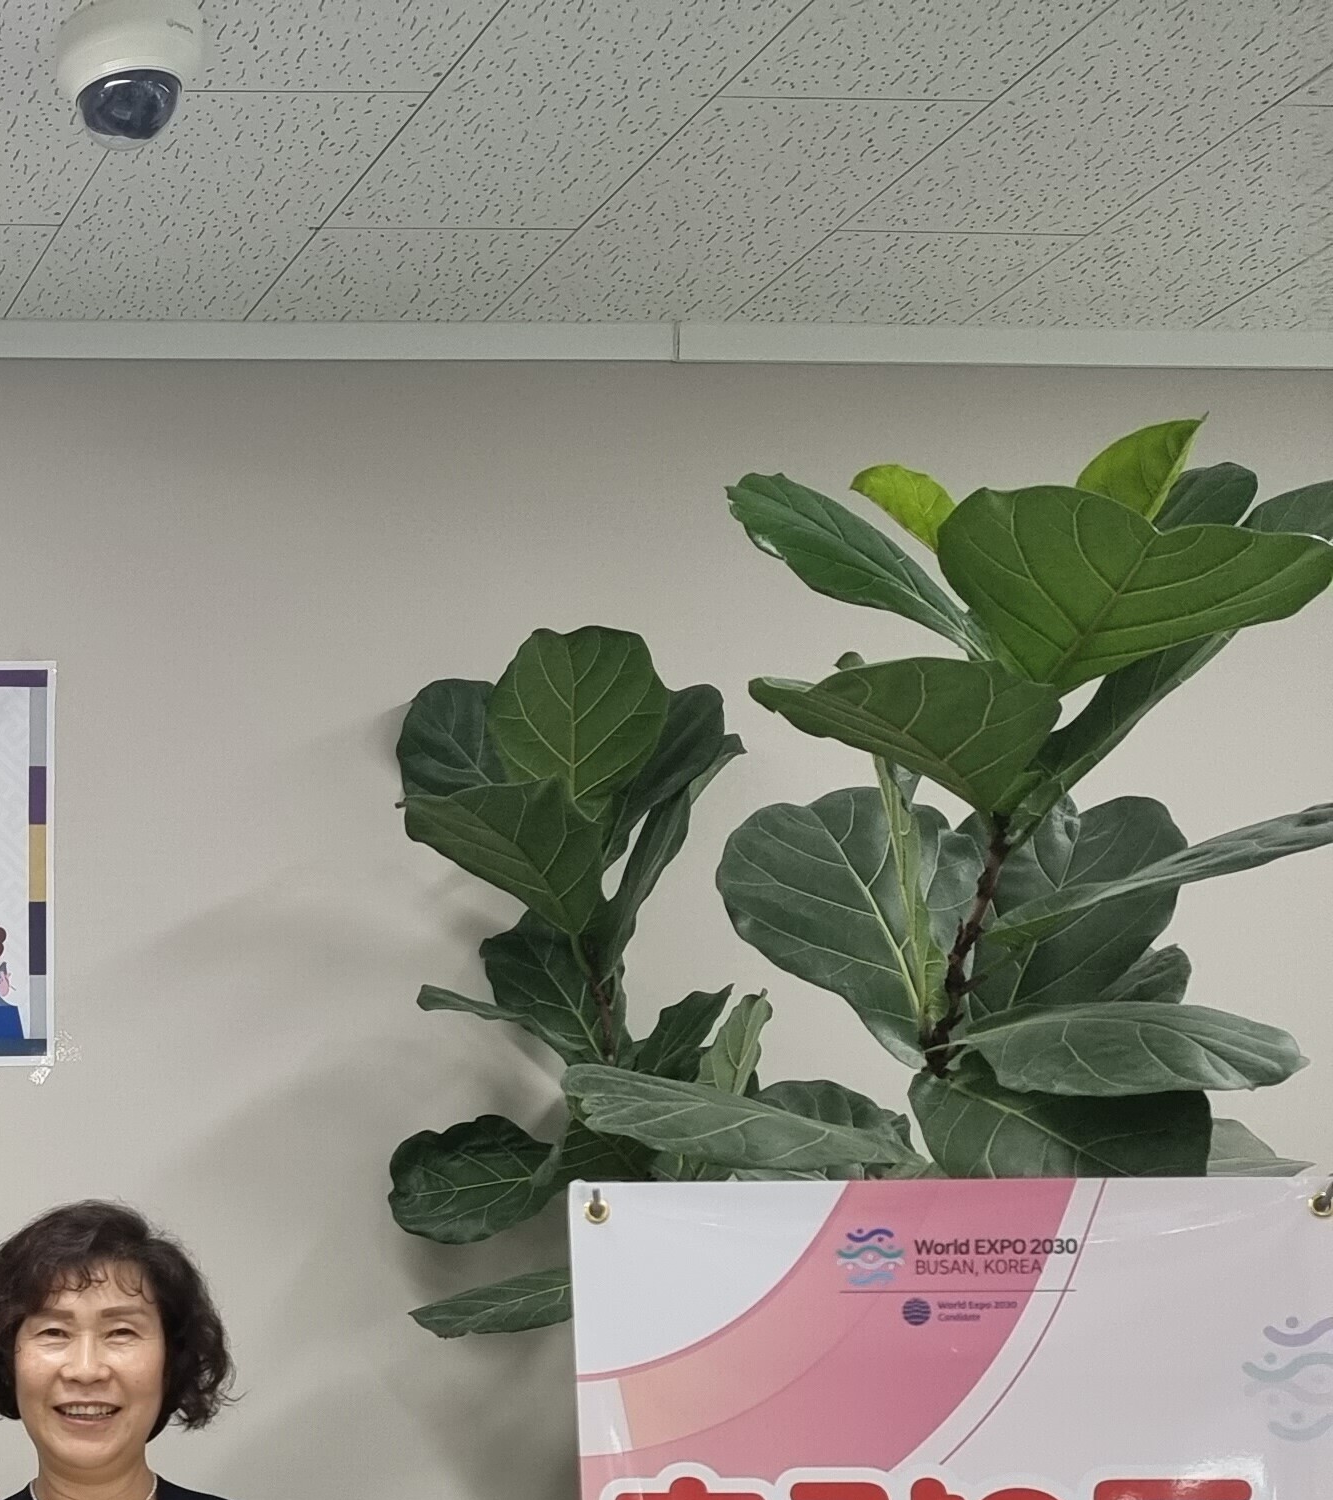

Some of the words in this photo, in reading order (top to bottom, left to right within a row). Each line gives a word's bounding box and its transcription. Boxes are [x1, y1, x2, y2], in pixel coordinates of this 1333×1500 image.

[914, 1239, 970, 1255] World
[975, 1239, 1026, 1255] EXPO
[1030, 1238, 1078, 1255] 2030
[915, 1259, 979, 1277] BUSAN,
[984, 1259, 1042, 1275] KOREA
[937, 1301, 966, 1310] World
[968, 1301, 993, 1311] Expo
[994, 1301, 1018, 1310] 2030
[937, 1313, 981, 1322] Candidate
